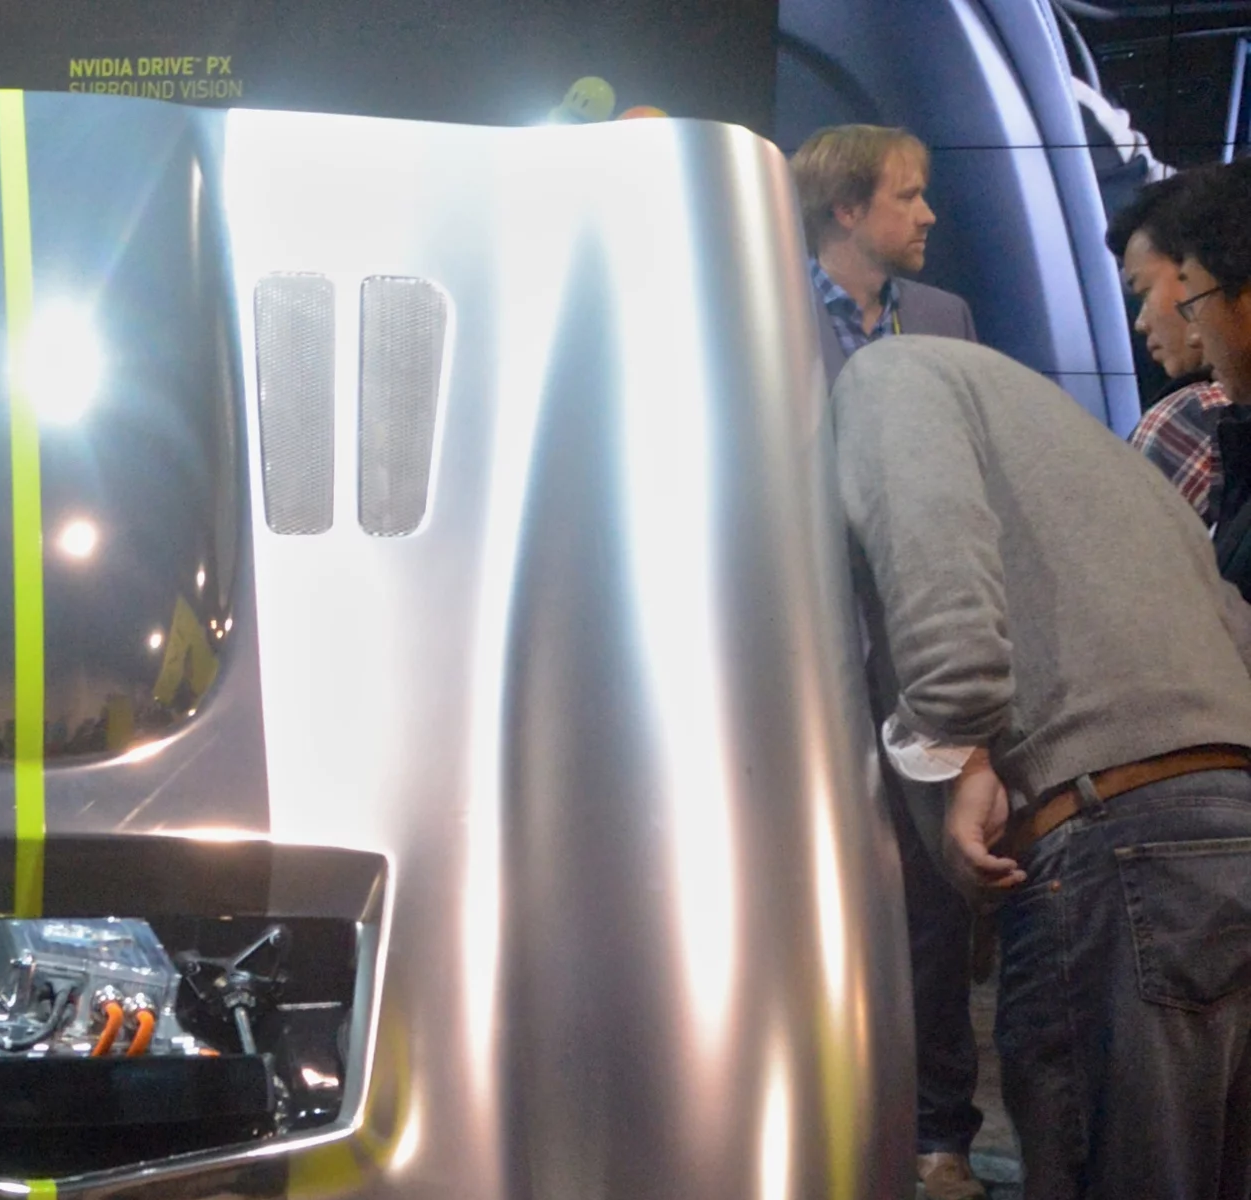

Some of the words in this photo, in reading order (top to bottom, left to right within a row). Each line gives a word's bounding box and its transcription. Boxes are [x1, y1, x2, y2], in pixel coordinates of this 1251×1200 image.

[69, 57, 133, 77] NVIDIA
[206, 55, 232, 75] PX
[180, 79, 243, 98] VISION
